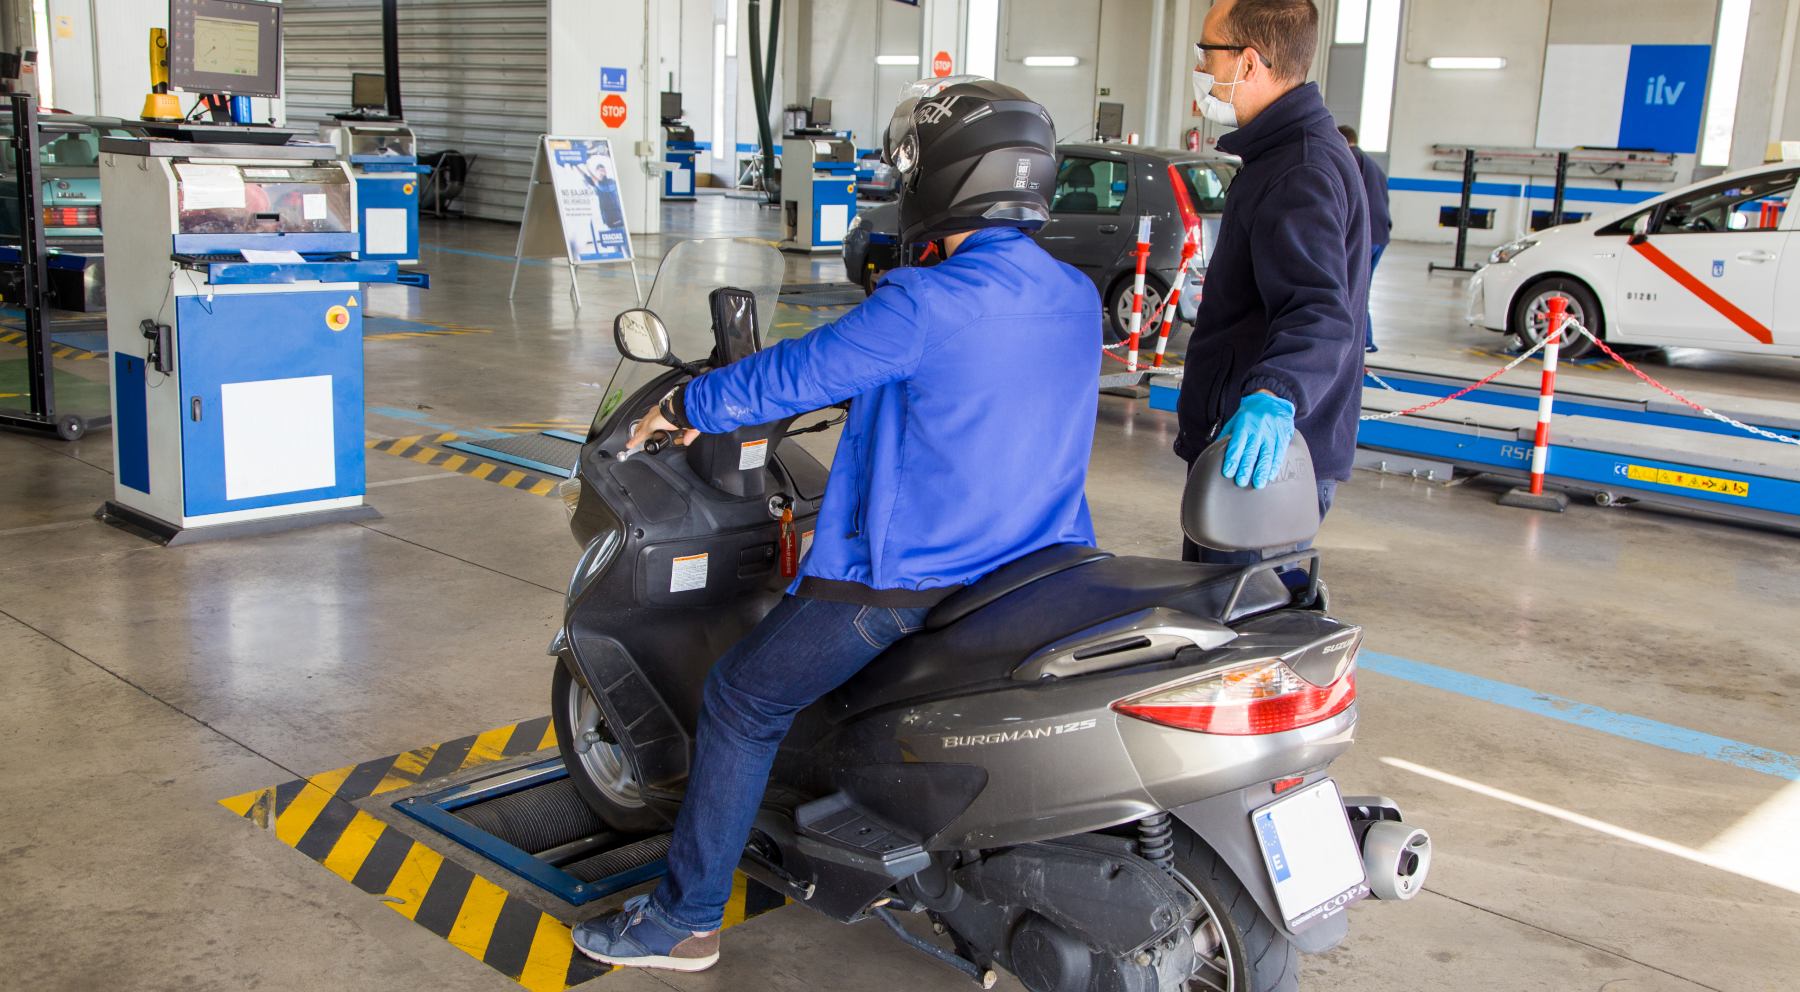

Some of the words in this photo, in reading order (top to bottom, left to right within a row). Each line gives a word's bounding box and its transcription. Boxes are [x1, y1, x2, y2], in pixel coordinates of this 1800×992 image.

[934, 60, 952, 70] STOP
[1645, 74, 1686, 105] itv
[602, 105, 625, 117] STOP
[942, 726, 1052, 749] BURGMAN
[1054, 718, 1097, 735] 125
[1272, 854, 1283, 871] E
[1323, 884, 1370, 912] COPA
